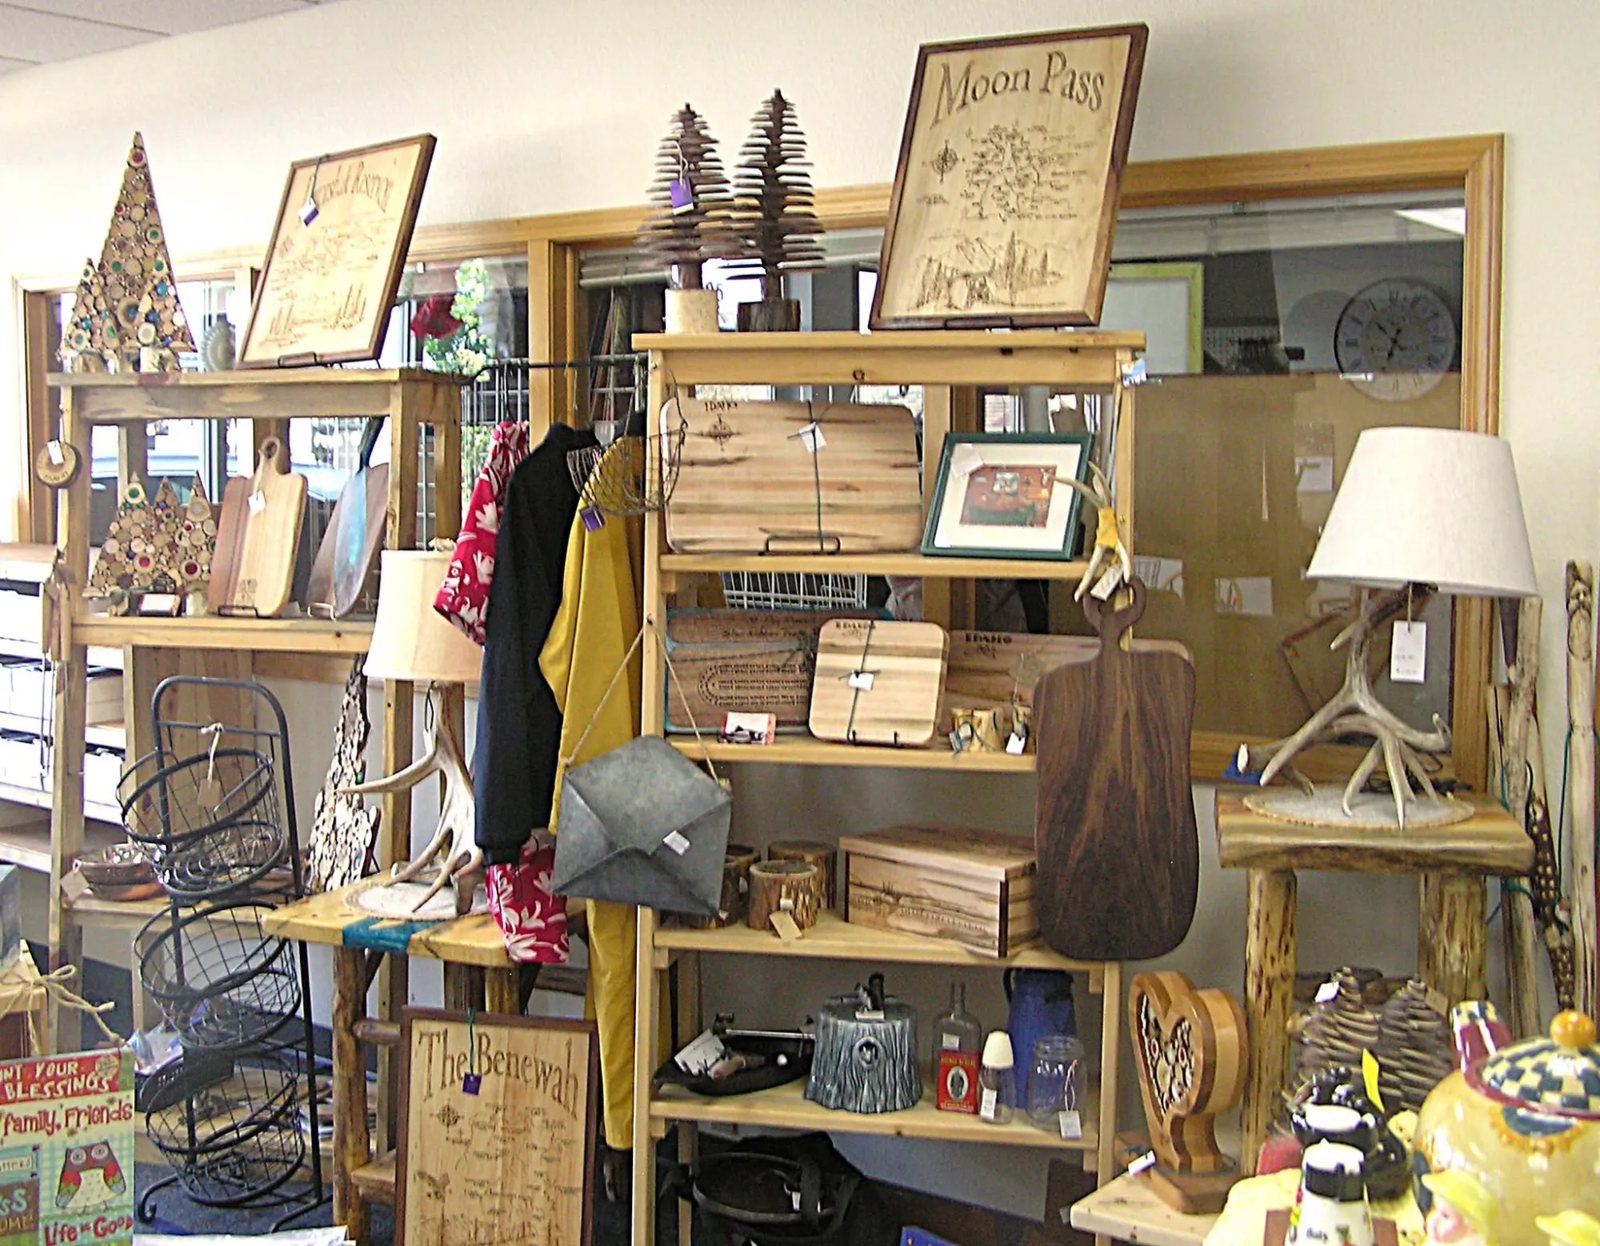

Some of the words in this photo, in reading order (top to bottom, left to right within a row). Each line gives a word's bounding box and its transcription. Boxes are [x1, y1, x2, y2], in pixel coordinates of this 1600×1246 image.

[930, 59, 1031, 130] Moon
[1039, 50, 1105, 113] Pass
[4, 1071, 112, 1100] BLESSINGS
[35, 1060, 80, 1079] YOUR
[418, 1027, 468, 1102] The
[476, 1031, 579, 1121] Benewah
